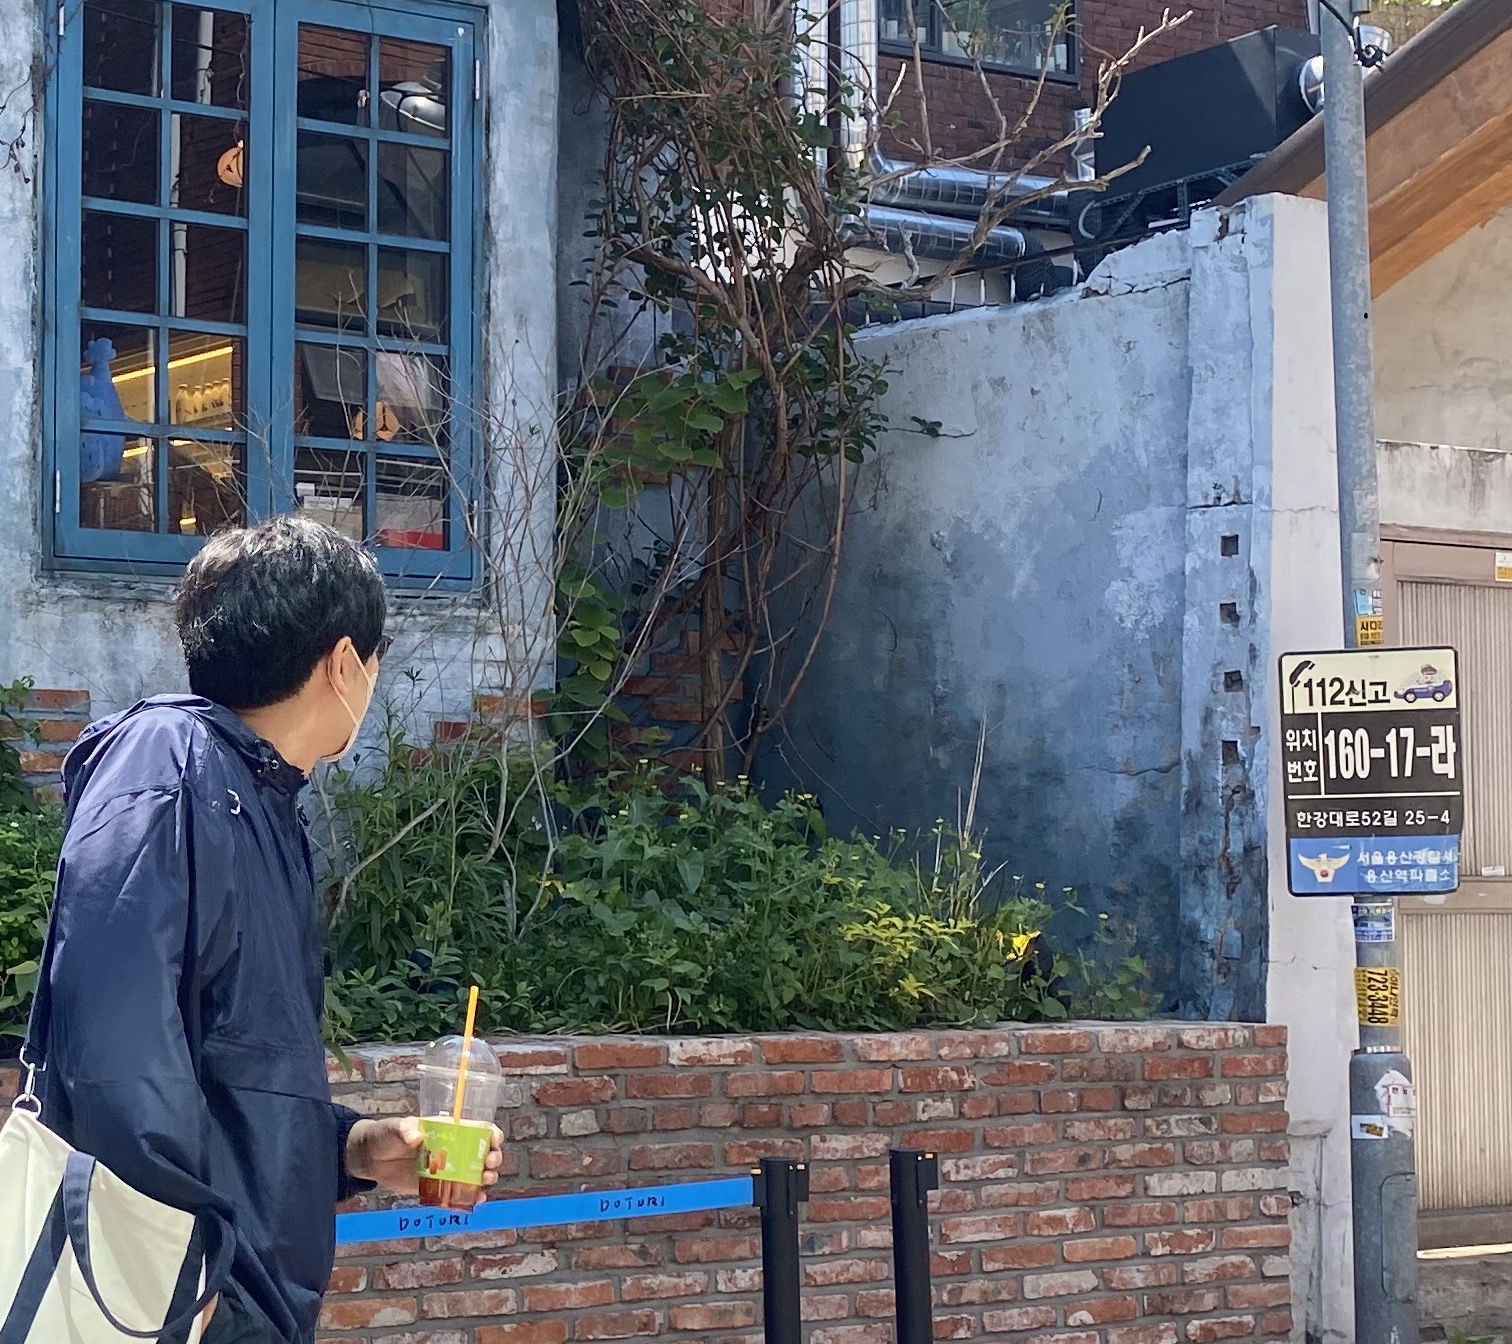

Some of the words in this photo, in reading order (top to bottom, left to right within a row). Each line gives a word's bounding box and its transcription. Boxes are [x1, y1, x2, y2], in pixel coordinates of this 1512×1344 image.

[1303, 676, 1391, 707] 112신고
[1285, 727, 1317, 752] 위치
[1324, 724, 1457, 780] 160-17-라
[1287, 758, 1319, 783] 번호
[1296, 810, 1398, 829] 한강대로52길
[1405, 809, 1451, 826] 25-4
